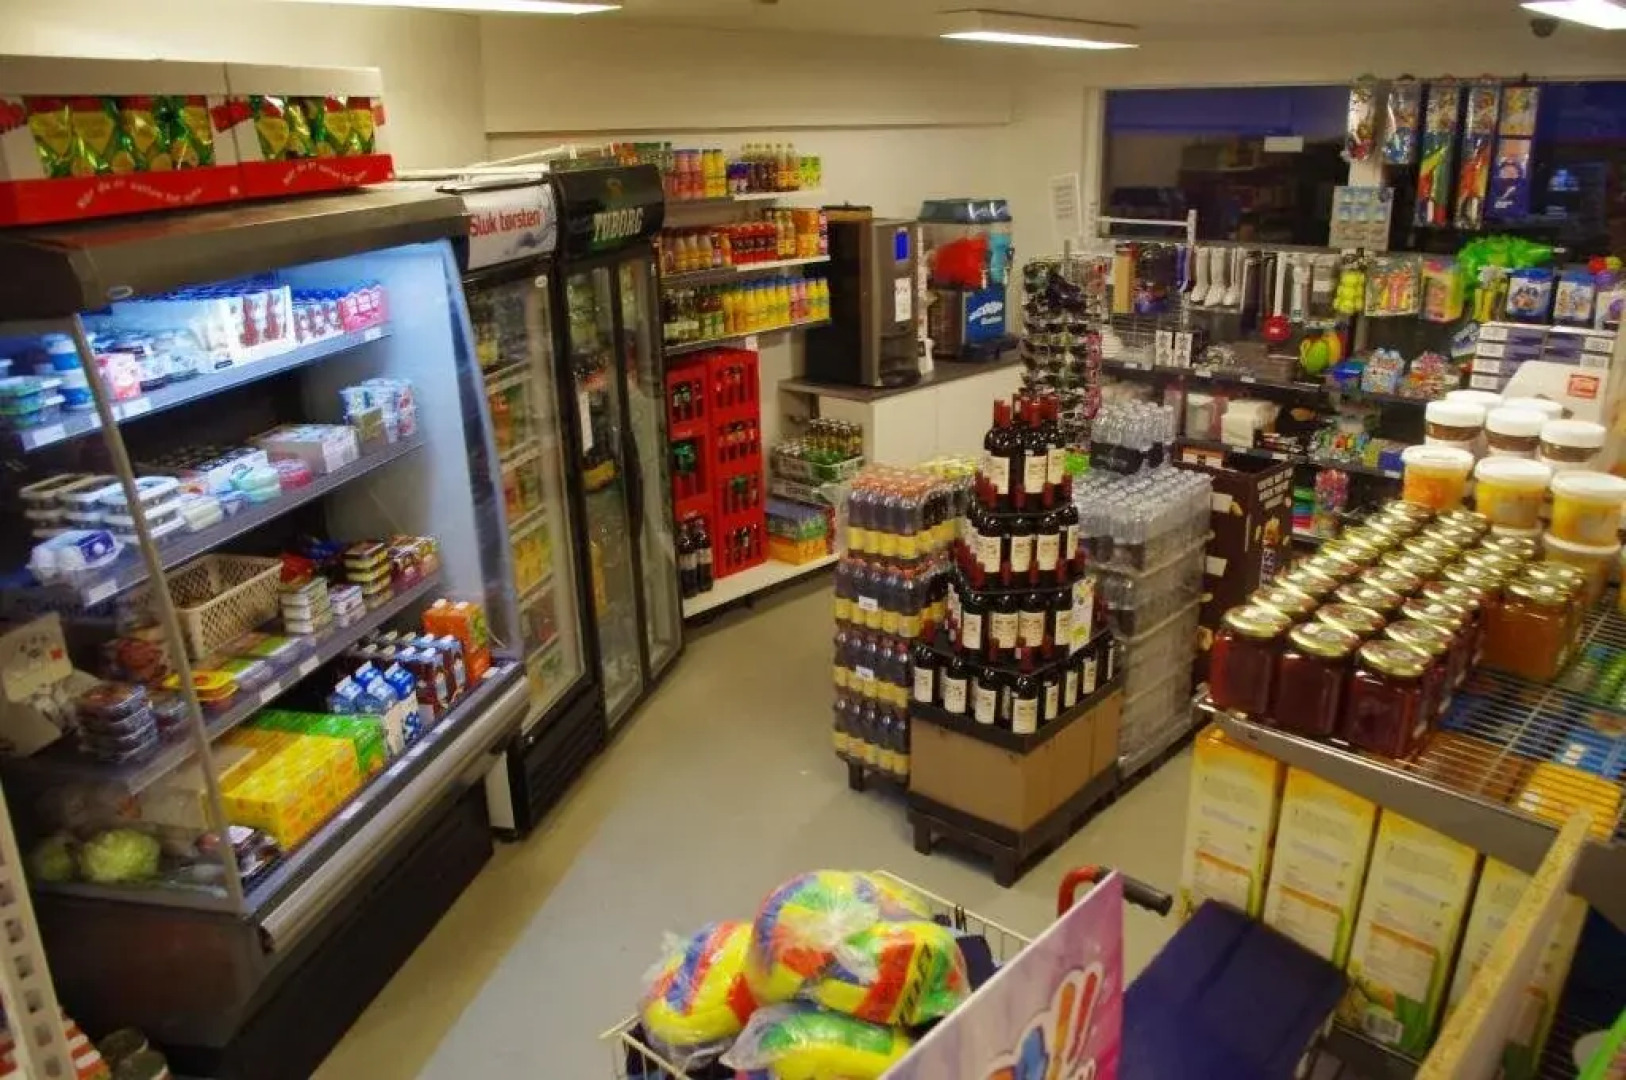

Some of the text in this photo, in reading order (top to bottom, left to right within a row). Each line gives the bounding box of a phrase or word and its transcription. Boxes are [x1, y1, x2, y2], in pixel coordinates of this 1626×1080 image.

[469, 208, 543, 237] Sluk tørsten
[593, 206, 643, 242] TUBORG
